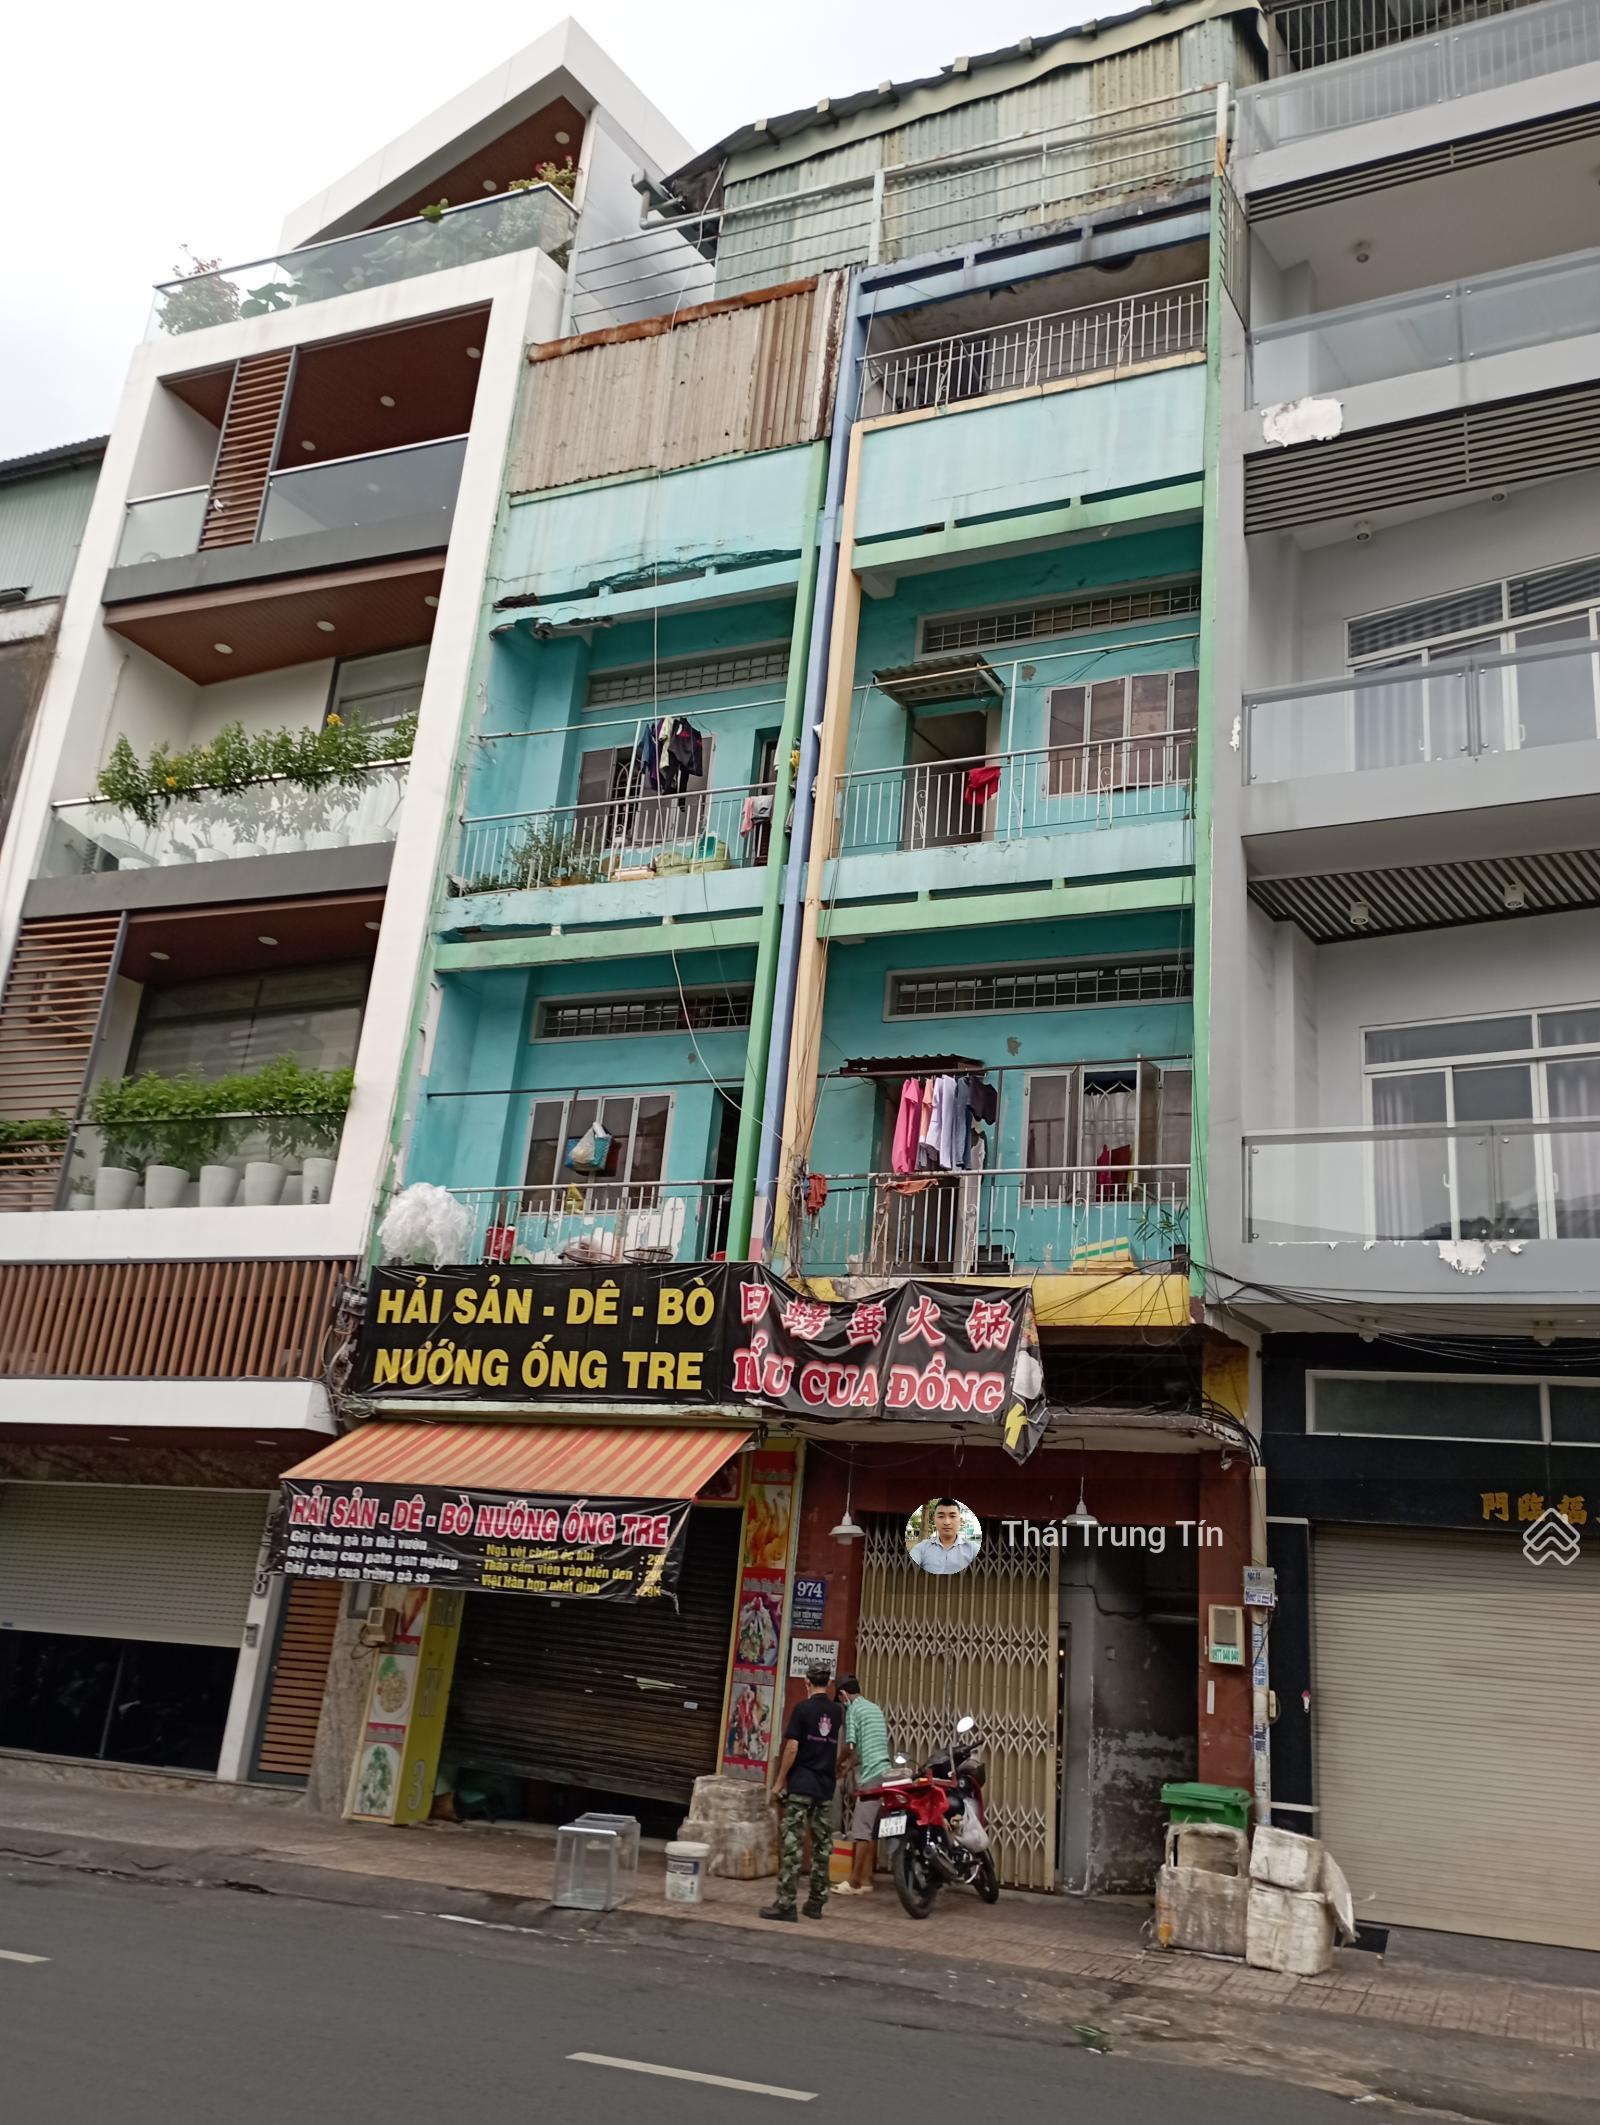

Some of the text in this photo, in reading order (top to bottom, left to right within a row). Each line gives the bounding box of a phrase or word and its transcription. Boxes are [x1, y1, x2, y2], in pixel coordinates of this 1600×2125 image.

[376, 1275, 443, 1324] HẢI
[453, 1274, 533, 1325] SẢN
[566, 1280, 621, 1325] DÊ
[656, 1278, 715, 1325] BÒ
[373, 1334, 704, 1391] NƯỚNG ỐNG TRE
[801, 1360, 879, 1409] CUA
[885, 1351, 1006, 1414] ĐỒNG
[289, 1485, 331, 1526] HẢI
[331, 1487, 379, 1529] SẢN
[391, 1494, 425, 1532] DÊ
[438, 1495, 473, 1536] BÒ
[474, 1500, 560, 1542] NƯỚNG
[563, 1499, 616, 1544] ỐNG
[622, 1514, 671, 1547] TRE
[797, 1581, 823, 1598] 974
[797, 1642, 835, 1654] CHO THUÊ
